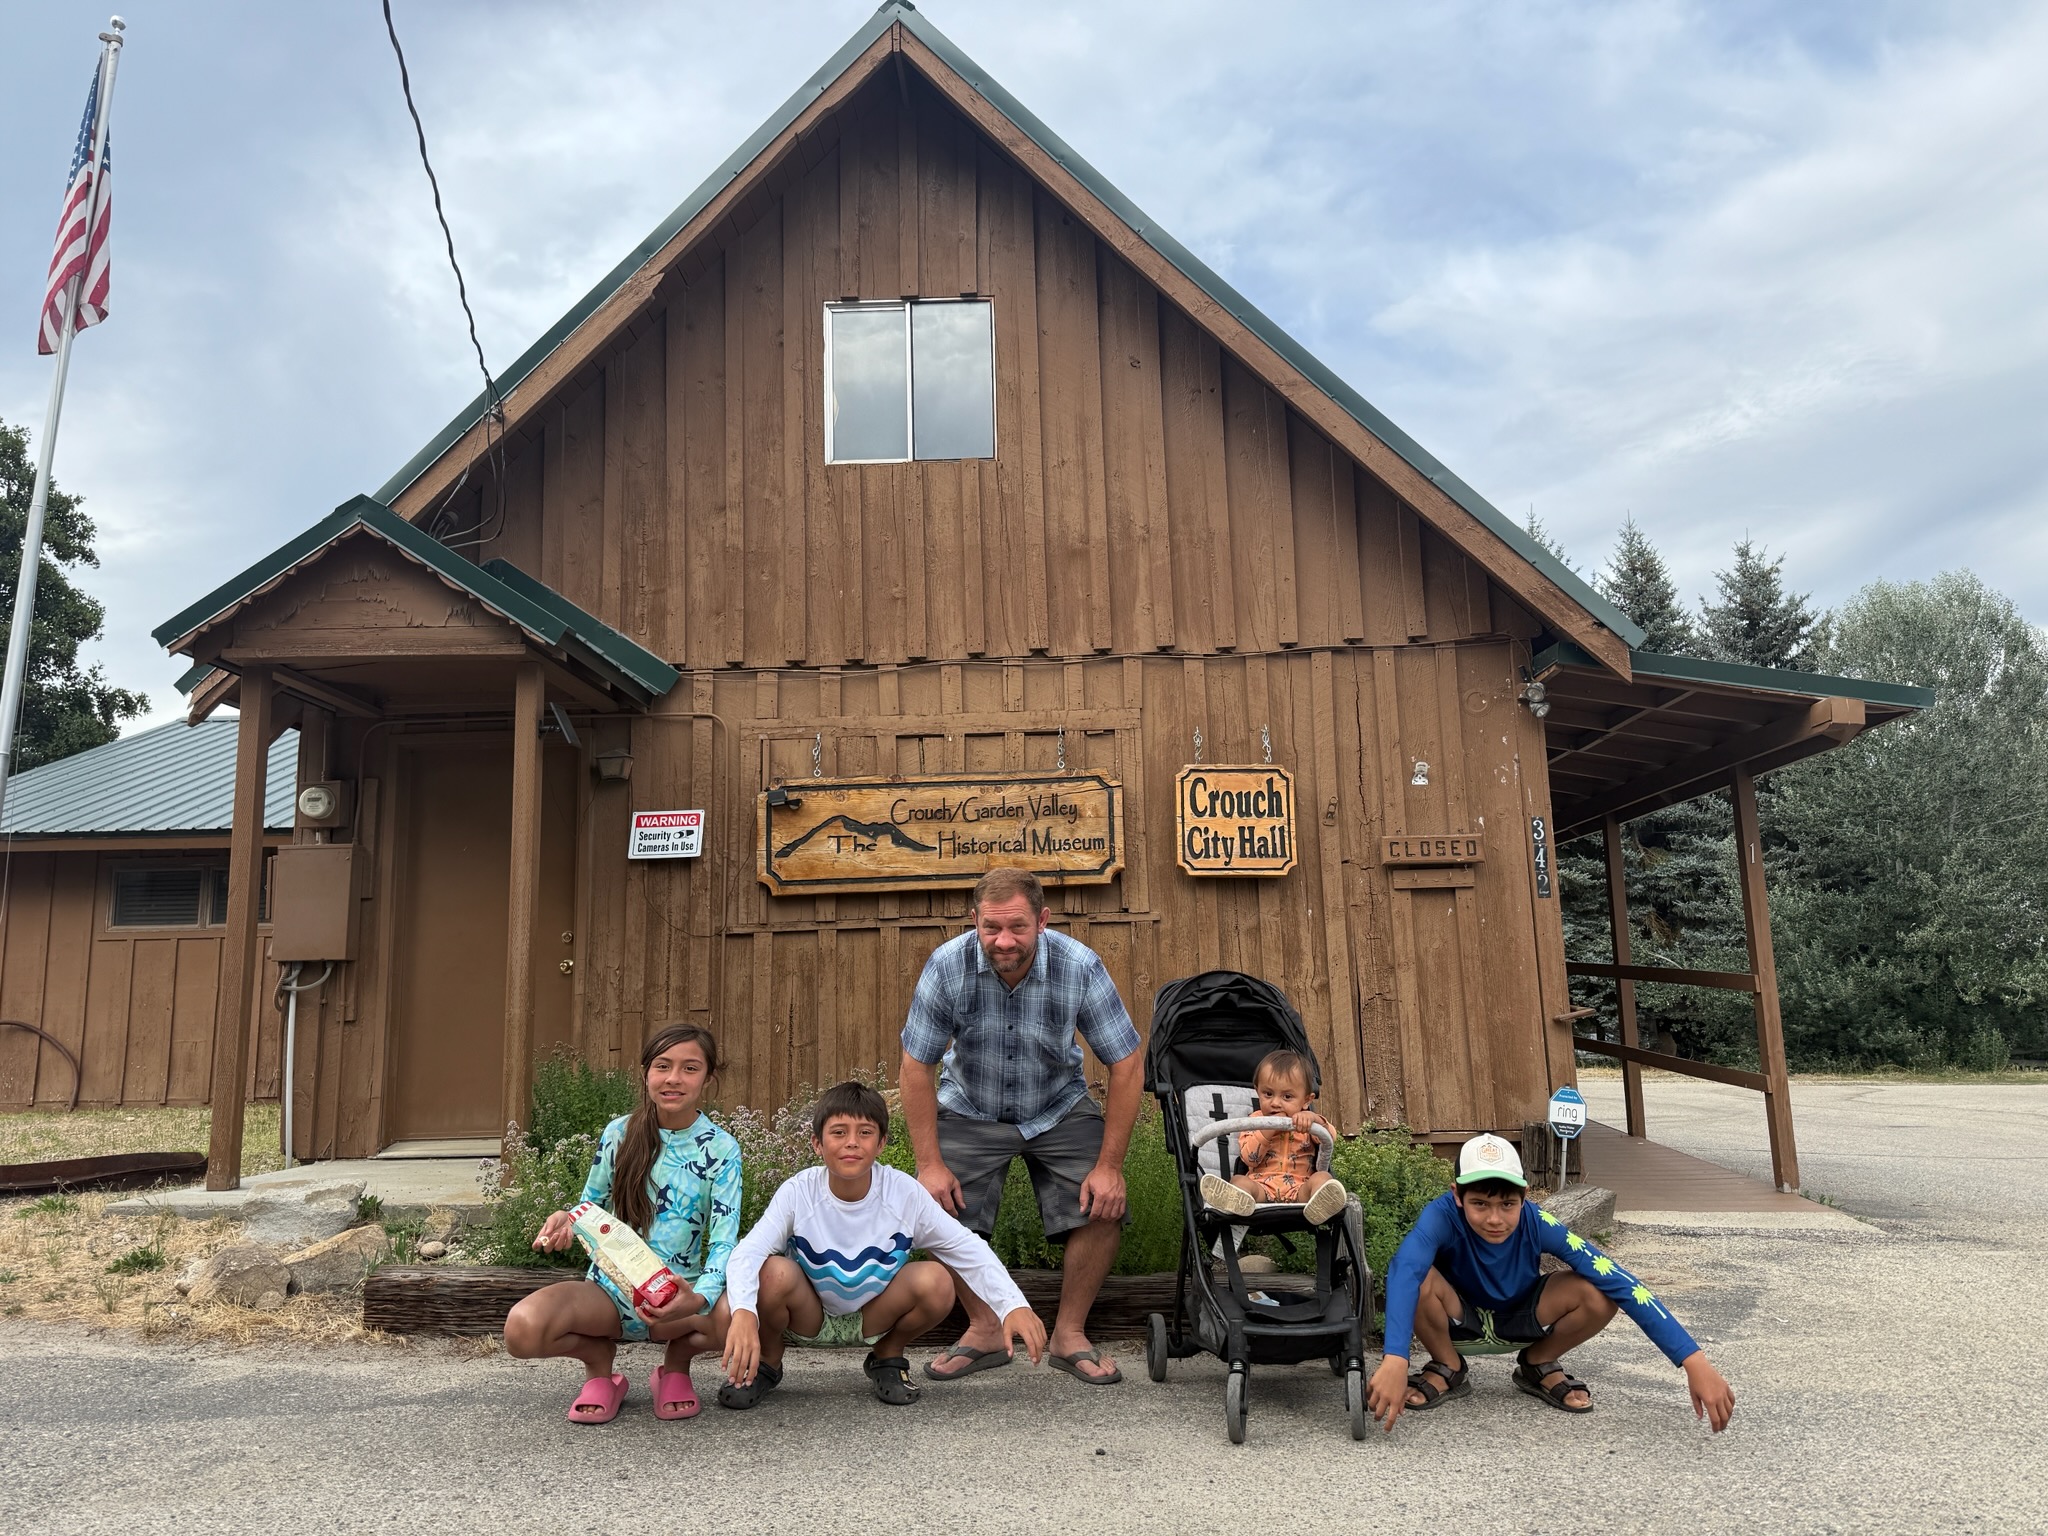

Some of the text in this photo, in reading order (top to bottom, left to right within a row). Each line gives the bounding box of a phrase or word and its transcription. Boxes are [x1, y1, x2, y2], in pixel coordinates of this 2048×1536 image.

[1189, 777, 1284, 819] Crouch
[890, 793, 1078, 825] Crouch/Garden Valley
[640, 815, 697, 827] WARNING
[638, 830, 671, 842] Security
[827, 827, 1105, 859] The Historical Museum
[637, 841, 694, 853] Cameras In Use
[1187, 825, 1288, 866] City Hall
[1389, 840, 1477, 858] CLOSED
[1557, 1104, 1578, 1122] ring
